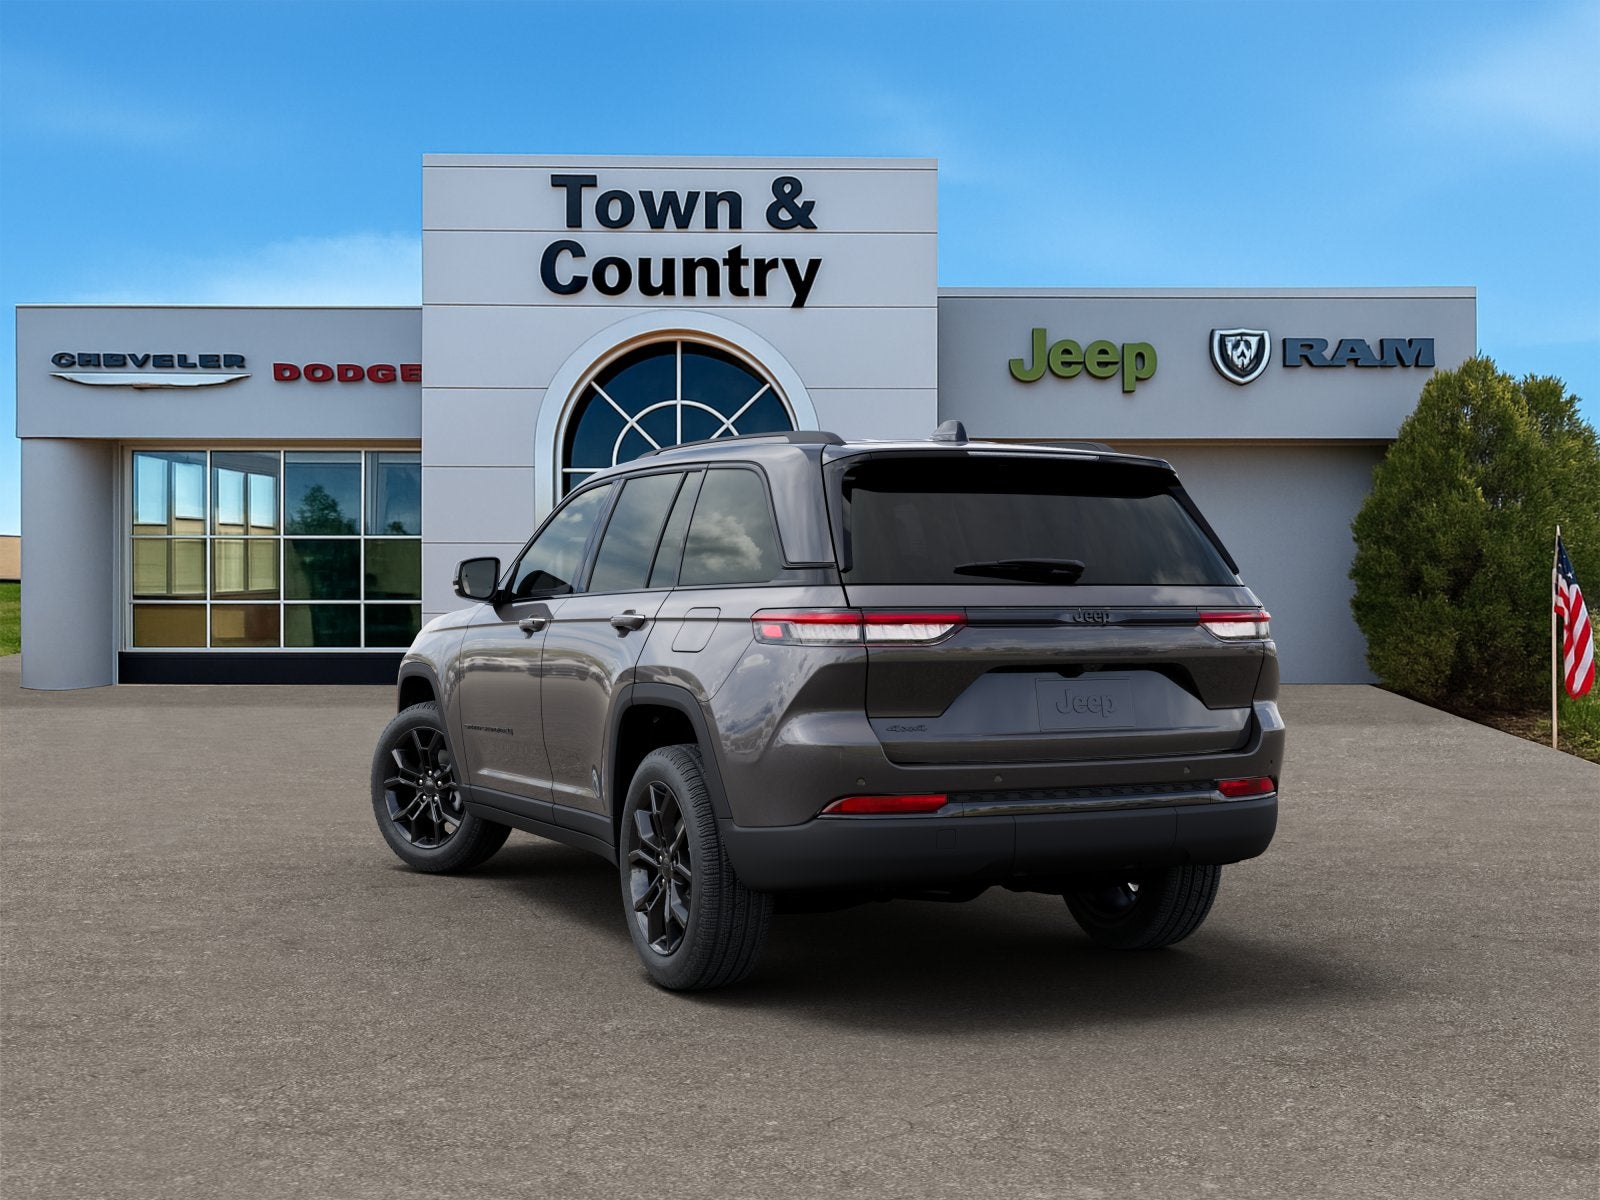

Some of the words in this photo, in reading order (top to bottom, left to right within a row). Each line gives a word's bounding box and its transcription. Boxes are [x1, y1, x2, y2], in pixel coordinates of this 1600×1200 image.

[551, 174, 742, 229] Town
[765, 176, 818, 230] &
[540, 239, 823, 308] Country
[1009, 328, 1157, 392] Jeep
[1282, 338, 1435, 367] RAM
[273, 363, 422, 383] DODGE
[1072, 607, 1111, 625] Jeep
[1055, 688, 1116, 718] Jeep
